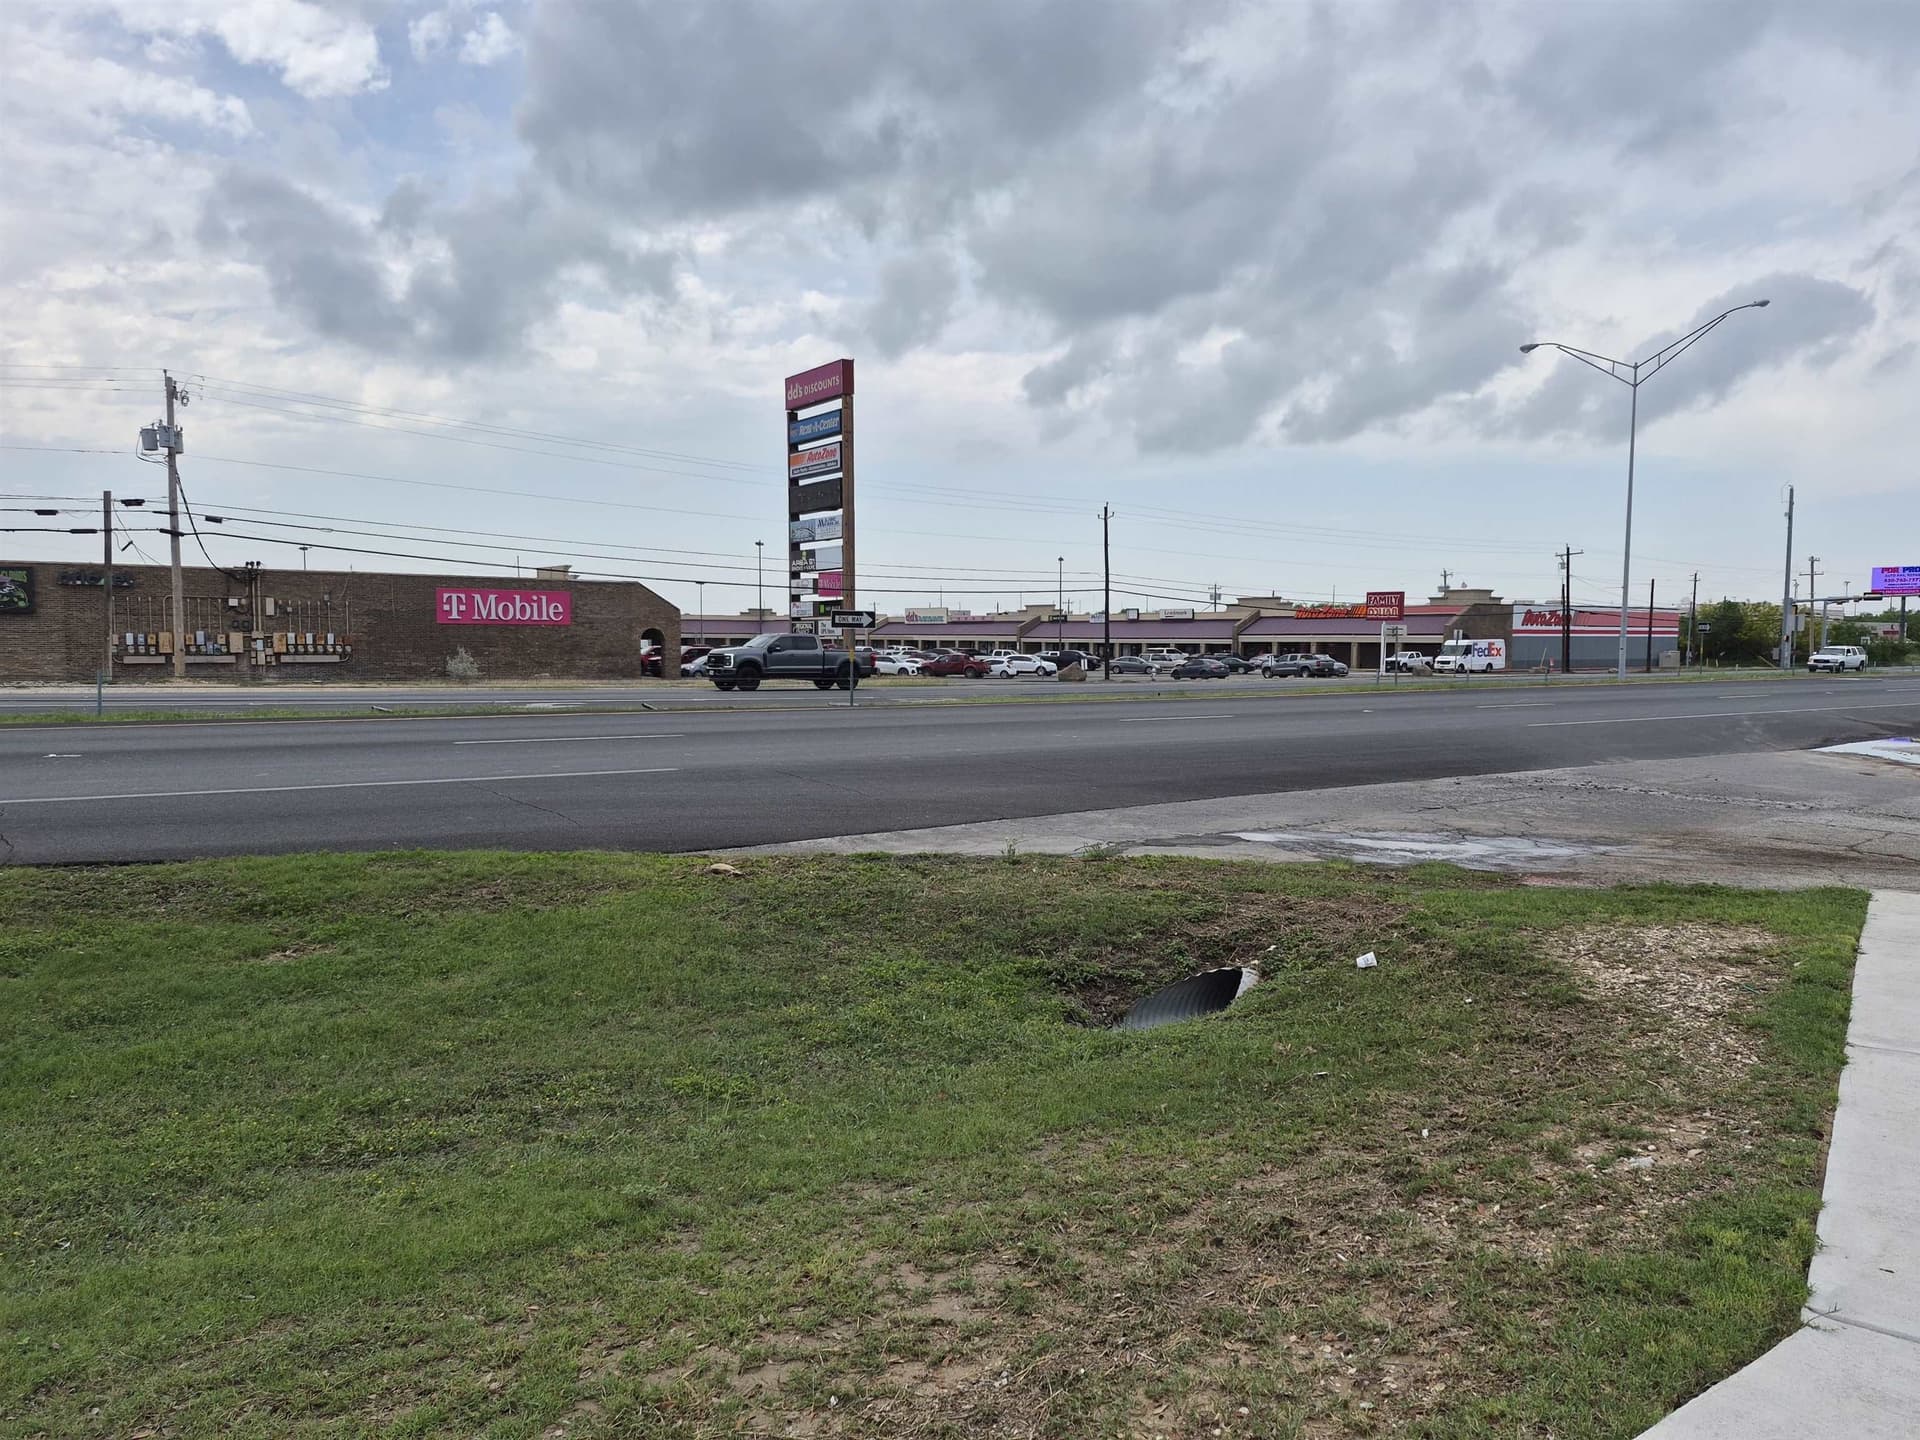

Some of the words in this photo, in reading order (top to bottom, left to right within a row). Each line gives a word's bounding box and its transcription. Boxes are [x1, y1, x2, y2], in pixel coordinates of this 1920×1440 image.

[788, 383, 803, 400] dd's
[804, 376, 839, 395] DISCOUNTS
[807, 448, 837, 463] AutoZone
[443, 592, 466, 620] T
[471, 593, 564, 622] Mobile
[1367, 594, 1400, 606] FAMILY
[838, 615, 849, 623] ONE
[852, 615, 862, 623] WAY
[1295, 604, 1348, 619] AutoZone
[1367, 606, 1399, 617] DOLLAR
[1471, 641, 1502, 658] FedEx
